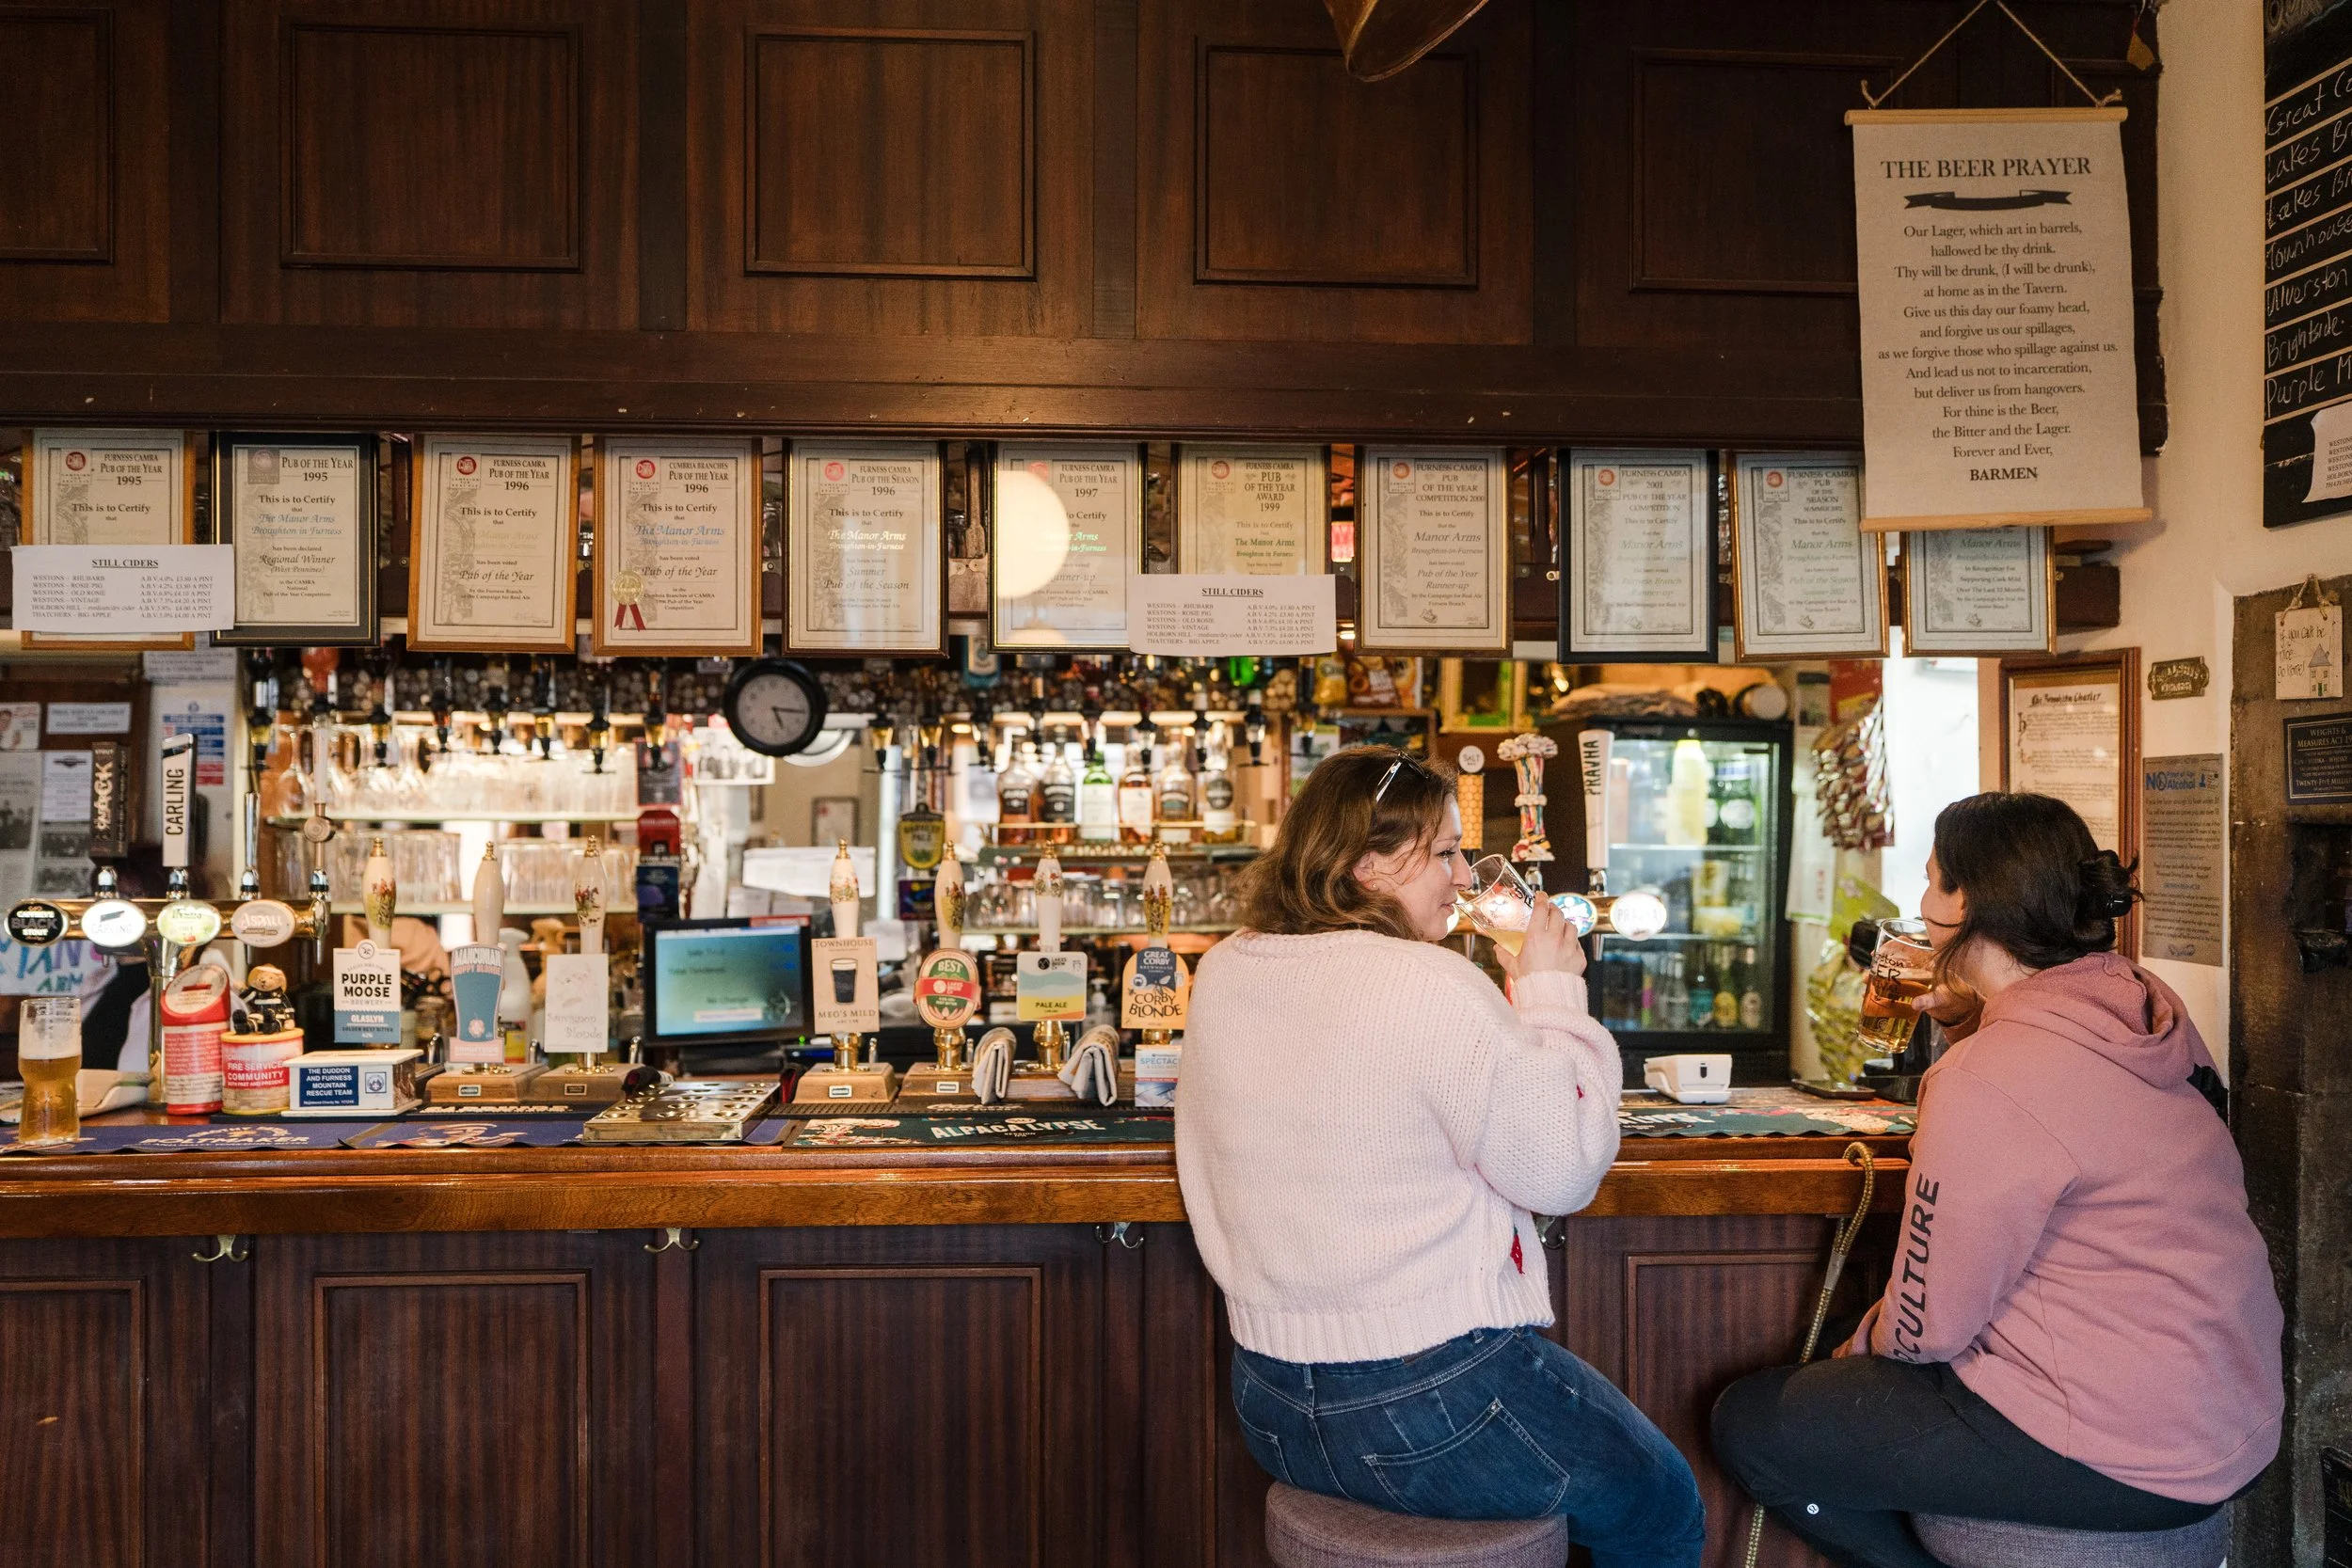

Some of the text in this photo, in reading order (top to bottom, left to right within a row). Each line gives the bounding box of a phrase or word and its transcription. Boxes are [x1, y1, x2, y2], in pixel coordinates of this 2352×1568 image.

[2266, 83, 2327, 135] Great
[2268, 136, 2320, 184] Lakes
[1881, 157, 2091, 179] THE BEER PRAYER
[2267, 184, 2321, 230] Lakes
[1903, 220, 2083, 240] Our Lager, which art in barrels,
[1931, 242, 2057, 259] hallowed be thy drink.
[1893, 260, 2096, 281] Thy will be drunk, (I will be drunk),
[2267, 265, 2348, 317] Ulverston
[1903, 300, 2090, 320] Give us this day our foamy head,
[1919, 321, 2076, 341] and forgive us our spillages,
[1878, 341, 2119, 362] as we forgive those who spillage against us.
[1905, 360, 2092, 379] And lead us not to incarceration,
[1914, 383, 2086, 400] but deliver us from hangovers.
[2266, 365, 2326, 418] Purple
[1942, 403, 2059, 419] For thine is the Beer,
[1931, 422, 2072, 439] the Bitter and the Lager.
[104, 453, 158, 462] FURNESS CAMRA
[1952, 443, 2054, 458] Forever and Ever,
[117, 476, 141, 485] 1995
[1261, 472, 1281, 482] PUB
[1969, 467, 2039, 481] BARMEN
[504, 482, 529, 491] 1996
[684, 483, 708, 493] 1996
[871, 486, 896, 496] 1996
[1074, 488, 1098, 497] 1997
[258, 495, 335, 506] This is to Certify
[1261, 502, 1279, 512] 1999
[828, 530, 907, 541] The Manor Arms
[1414, 532, 1481, 542] Manor Arms
[459, 570, 534, 582] Pub of the Year
[1583, 739, 1601, 796] PRAVHA
[166, 768, 184, 835] CARLING
[10, 917, 57, 929] BLACK
[241, 912, 281, 927] ASPALL
[23, 928, 49, 937] STOUT
[815, 940, 874, 948] TOWNHOUSE
[938, 961, 963, 973] BEST
[342, 973, 391, 985] PURPLE
[344, 986, 389, 997] MOOSE
[1135, 993, 1176, 1006] CORBY
[850, 1008, 877, 1018] MILD
[1129, 1004, 1184, 1018] BLONDE
[228, 1061, 245, 1070] FIRE
[228, 1070, 284, 1082] COMMUNITY
[1893, 1172, 1940, 1360] CULTURE
